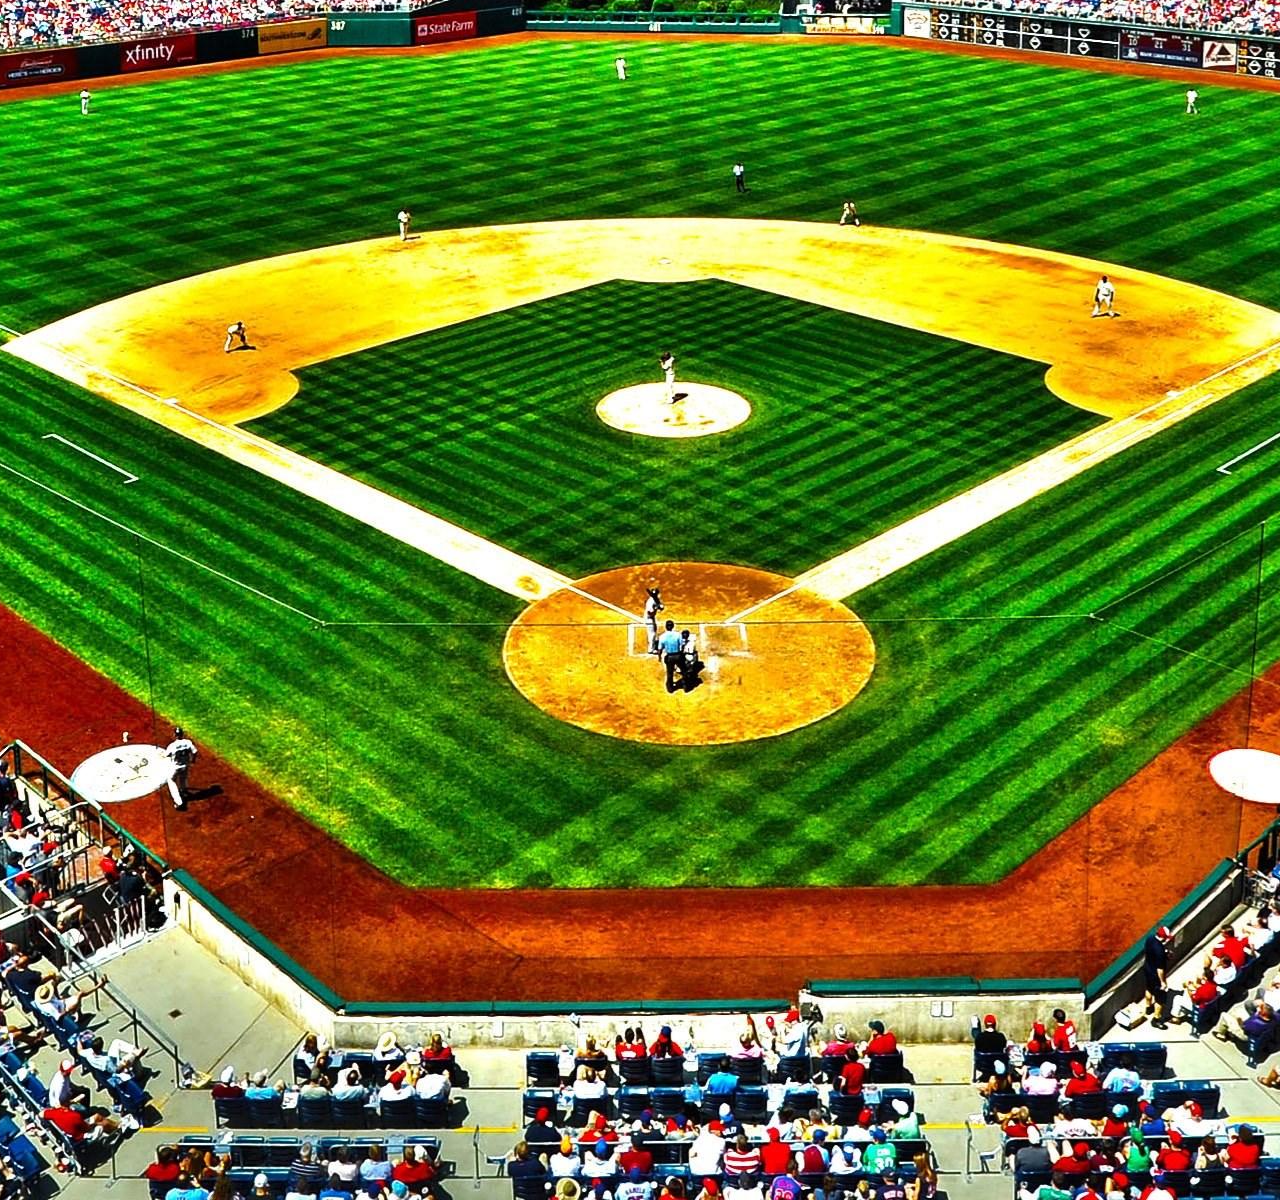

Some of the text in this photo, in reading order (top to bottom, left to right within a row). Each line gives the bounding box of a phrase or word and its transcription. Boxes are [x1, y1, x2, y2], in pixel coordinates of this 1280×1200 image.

[428, 19, 474, 35] State Farm
[125, 42, 175, 65] xfinity
